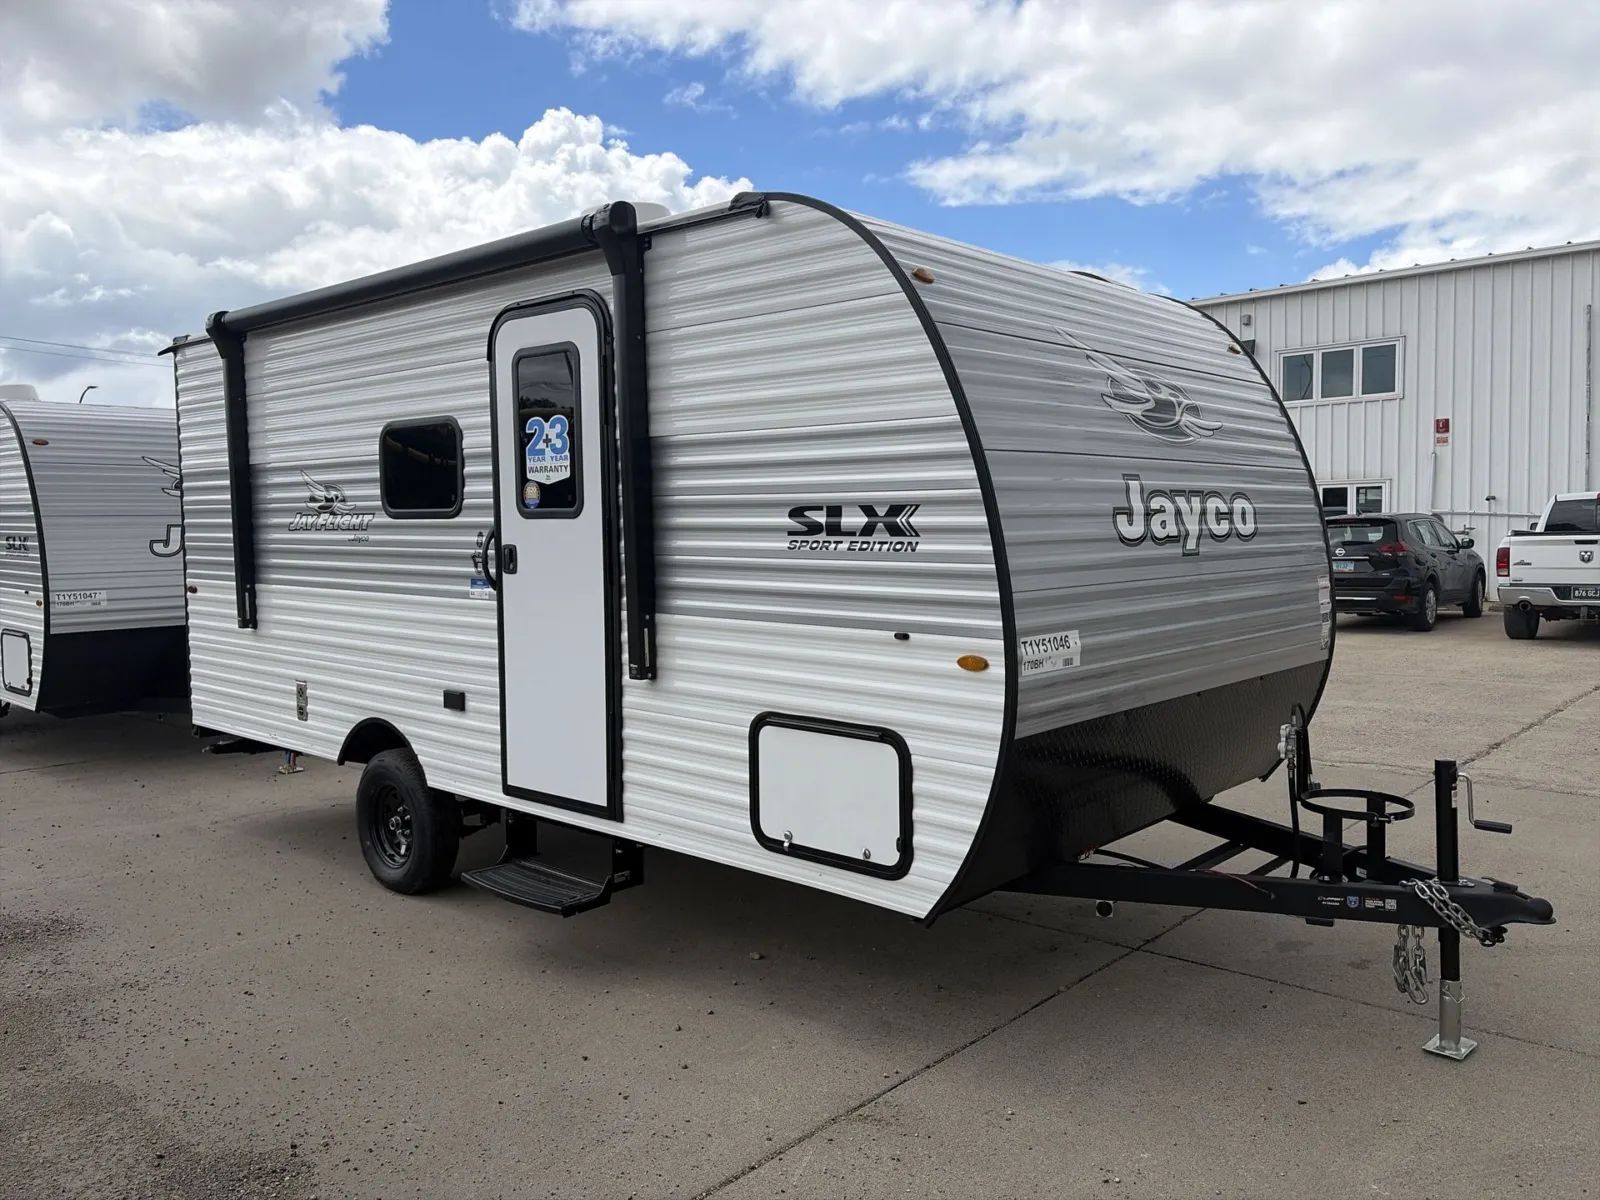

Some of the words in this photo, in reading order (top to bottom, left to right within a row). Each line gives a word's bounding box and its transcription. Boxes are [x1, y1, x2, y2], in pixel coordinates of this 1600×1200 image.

[528, 465, 568, 474] WARRANTY
[787, 504, 921, 537] SLX
[1113, 473, 1258, 557] Jayco
[787, 540, 843, 551] SPORT
[846, 541, 920, 552] EDITION
[1021, 634, 1071, 656] T1Y51046
